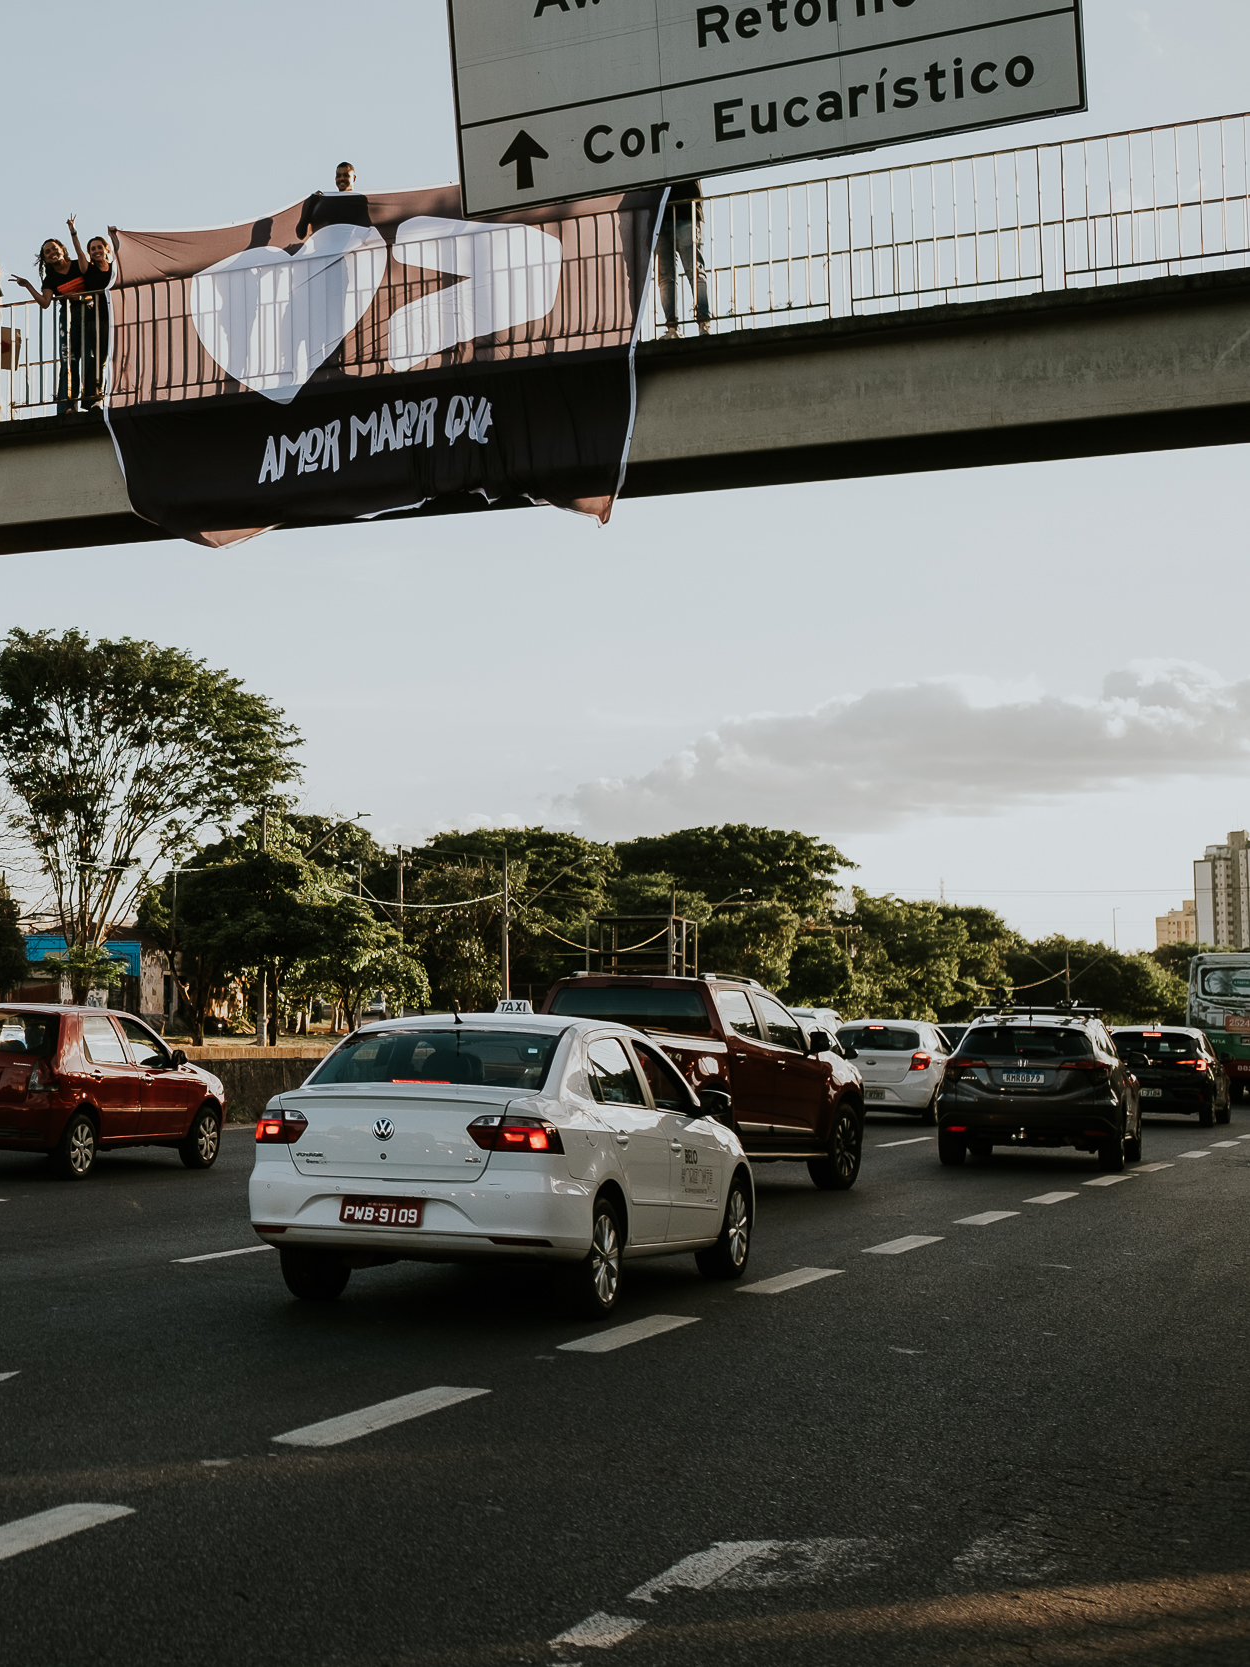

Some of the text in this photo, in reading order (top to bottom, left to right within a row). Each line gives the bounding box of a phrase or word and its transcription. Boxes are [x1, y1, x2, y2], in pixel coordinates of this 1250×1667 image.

[583, 54, 1036, 165] Cor. Eucarístico
[258, 419, 341, 485] AMOR
[500, 1001, 527, 1013] TAXI
